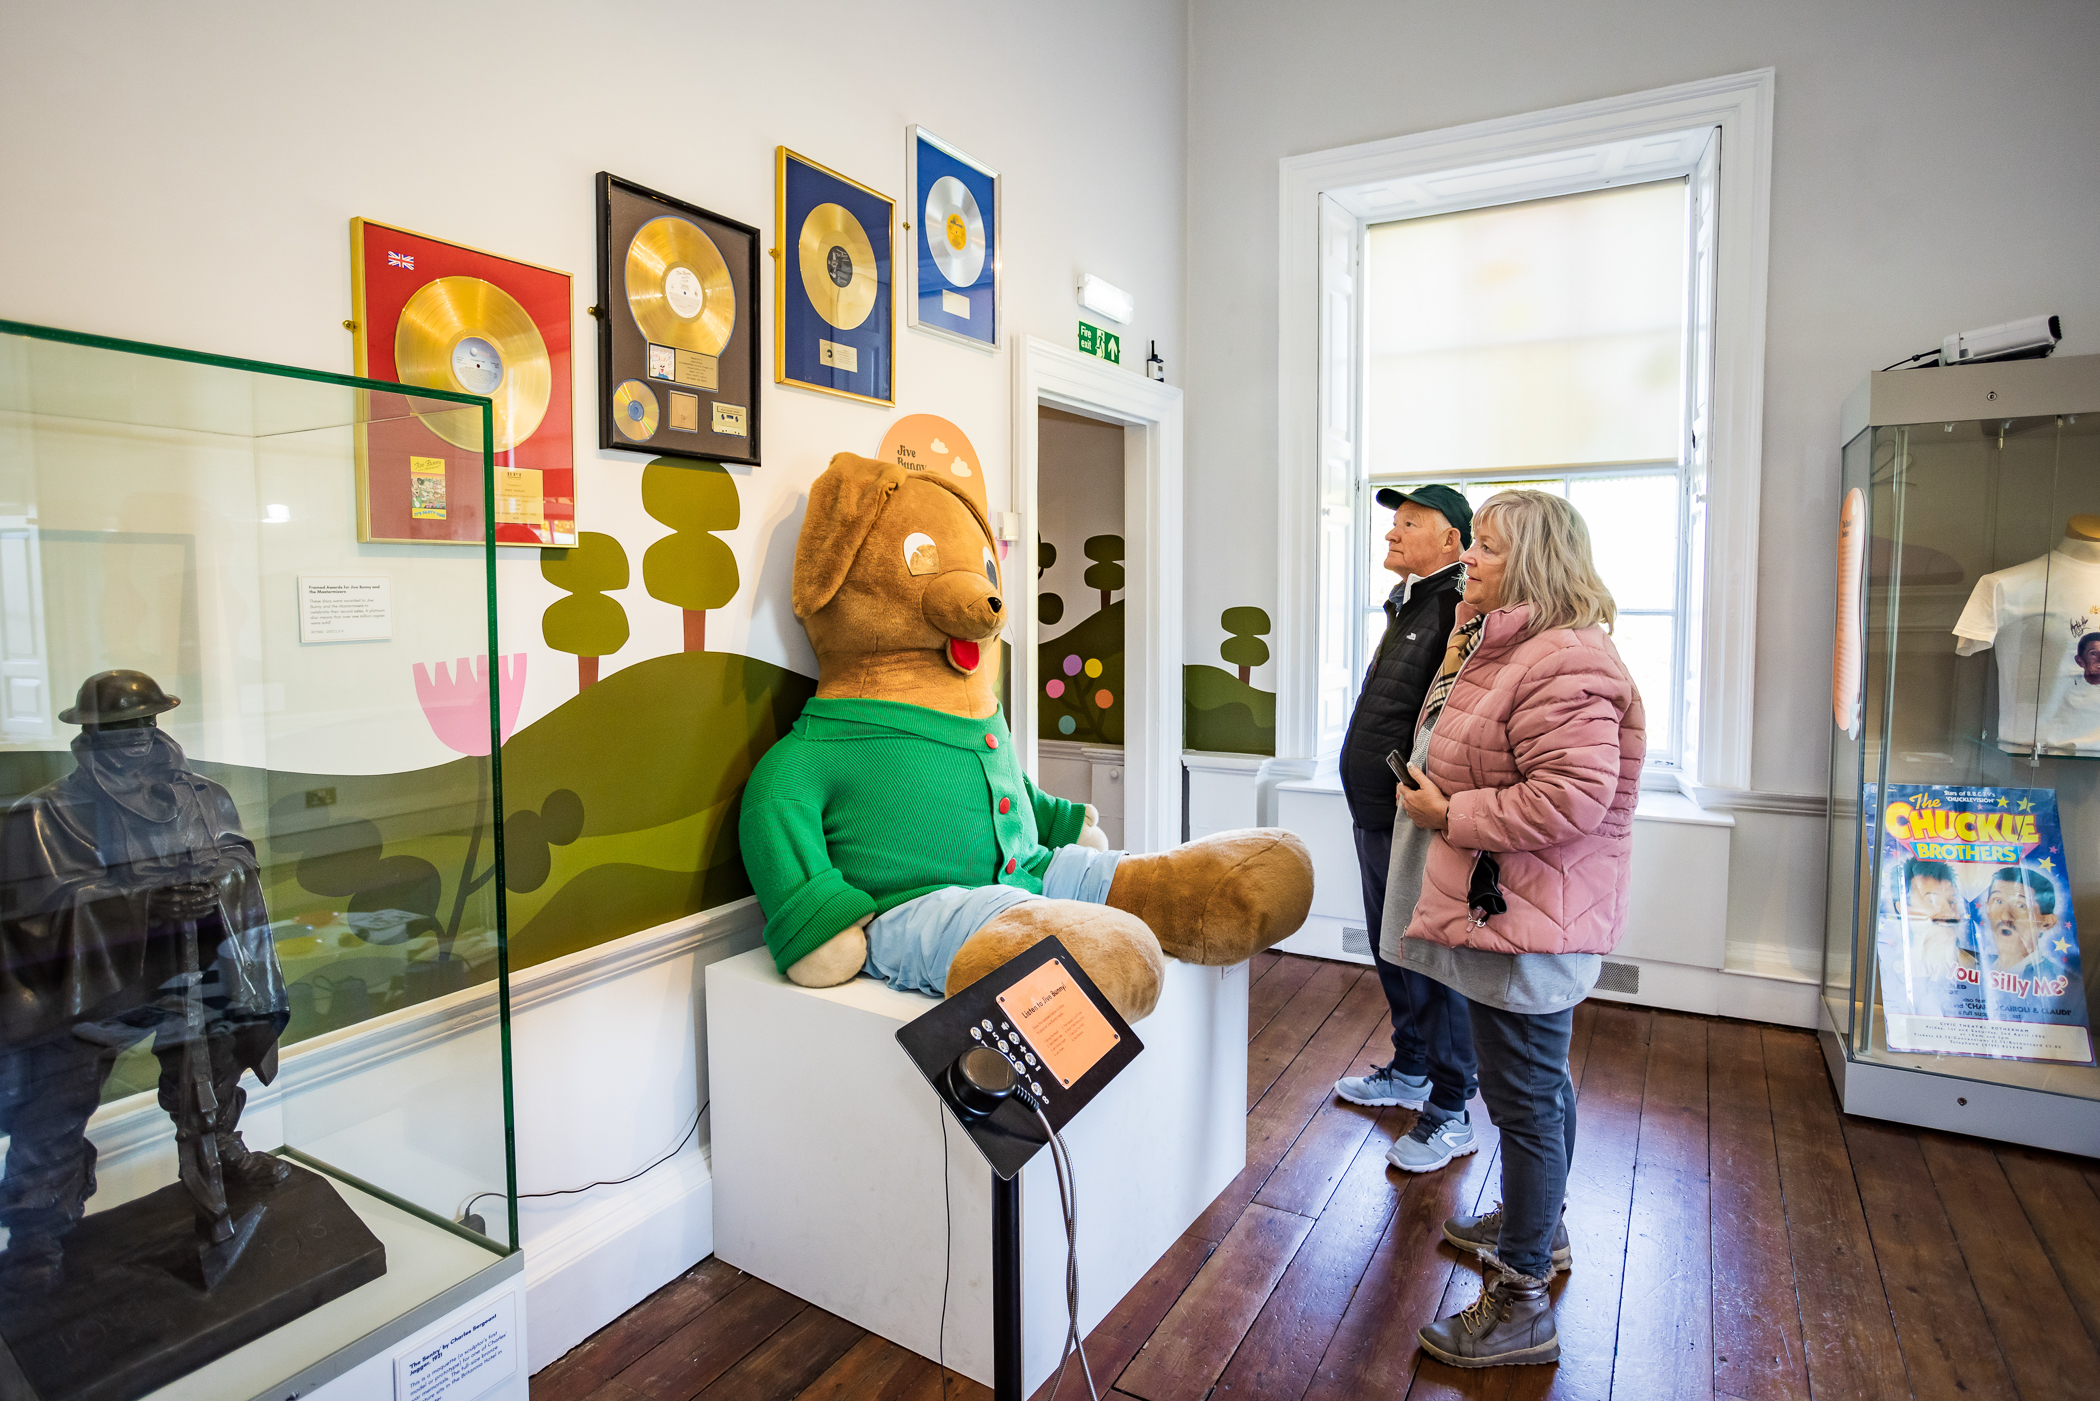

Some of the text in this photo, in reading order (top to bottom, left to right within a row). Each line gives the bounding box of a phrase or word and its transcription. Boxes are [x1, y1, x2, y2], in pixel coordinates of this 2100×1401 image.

[1081, 325, 1092, 338] Fire
[1081, 338, 1092, 350] exit
[897, 444, 916, 458] Jive
[1909, 793, 1942, 809] The
[1886, 802, 2040, 843] CHUCKLE
[1916, 843, 2017, 862] BROTHERS
[1945, 961, 1980, 985] You
[1988, 970, 2031, 999] Silly
[1021, 1005, 1038, 1019] Listen
[1042, 994, 1053, 1004] Jive
[1050, 982, 1067, 997] Bunny!
[992, 1032, 1000, 1041] 5
[1009, 1052, 1016, 1062] 6
[1025, 1073, 1032, 1083] 7
[1042, 1095, 1049, 1104] 8
[450, 1330, 471, 1345] Charles
[472, 1313, 497, 1331] Sergeant
[410, 1380, 420, 1388] This
[432, 1357, 457, 1375] maquette
[464, 1337, 487, 1355] sculptor's
[488, 1331, 497, 1339] first
[451, 1369, 460, 1378] The
[461, 1357, 480, 1371] full-size
[481, 1346, 498, 1358] bronze
[410, 1382, 427, 1396] model
[435, 1359, 461, 1382] prototype)
[470, 1350, 480, 1358] one
[436, 1387, 445, 1395] sits
[461, 1362, 483, 1378] Britannia
[484, 1352, 497, 1363] Hotel
